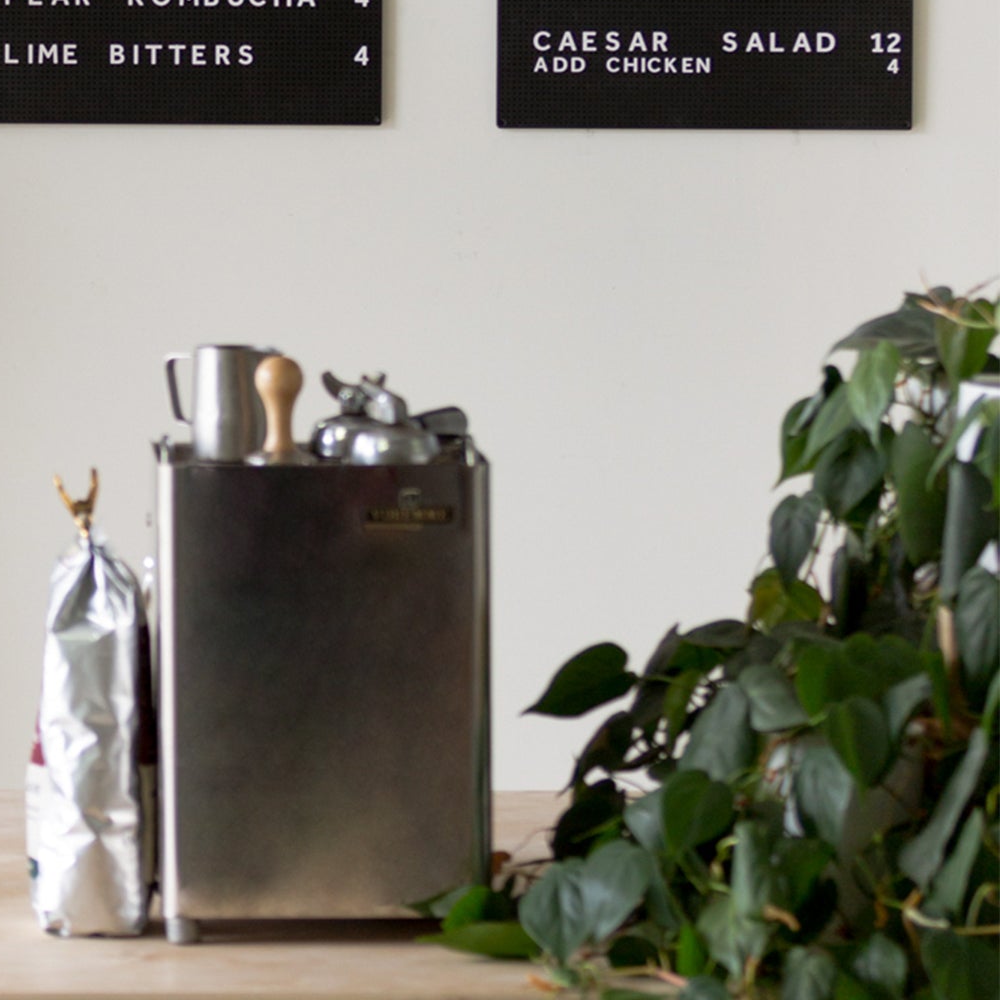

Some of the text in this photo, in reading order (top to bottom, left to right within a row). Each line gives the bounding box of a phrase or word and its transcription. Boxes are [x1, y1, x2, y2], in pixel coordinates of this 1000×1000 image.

[532, 30, 902, 54] CAESAR SALAD 12
[4, 43, 369, 66] LIME BITTERS 4
[533, 56, 900, 75] ADD CHICKEN 4
